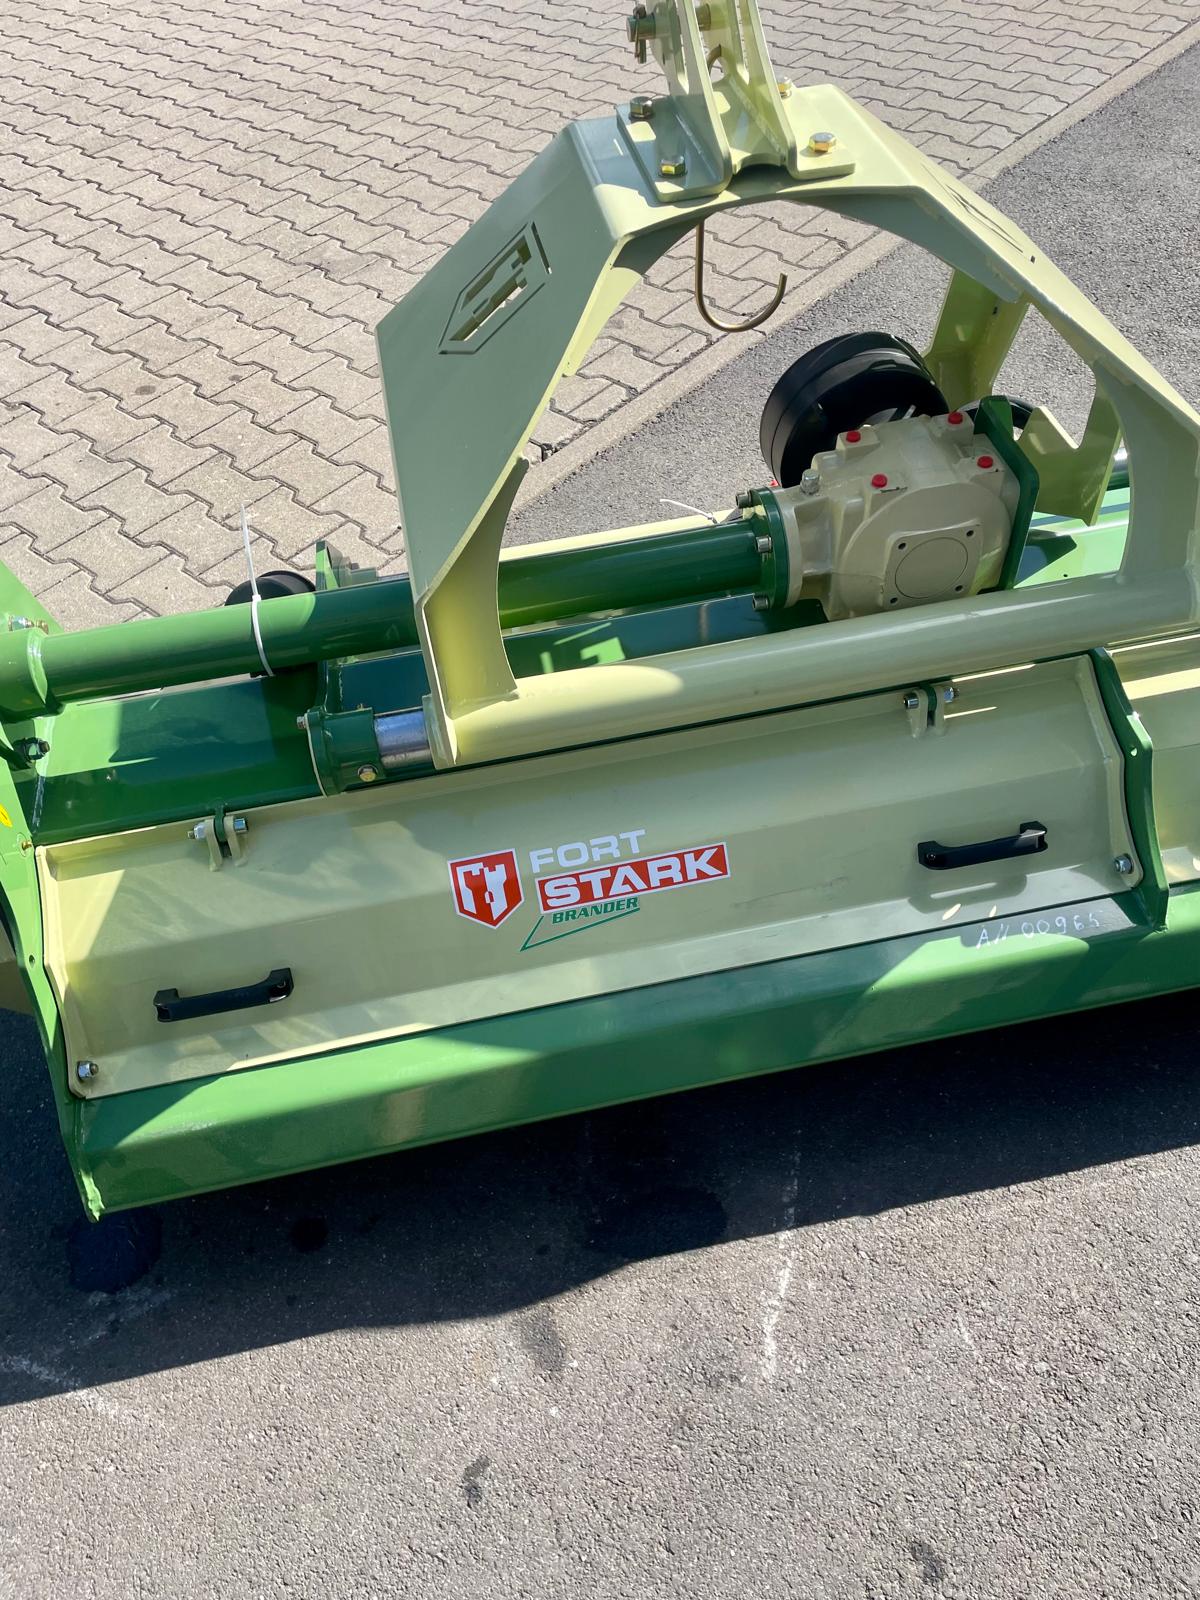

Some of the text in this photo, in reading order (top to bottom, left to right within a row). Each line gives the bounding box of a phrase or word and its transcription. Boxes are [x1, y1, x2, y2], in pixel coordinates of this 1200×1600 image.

[529, 829, 645, 873] FORT
[544, 848, 722, 907] STARK
[552, 897, 638, 924] BRANDER
